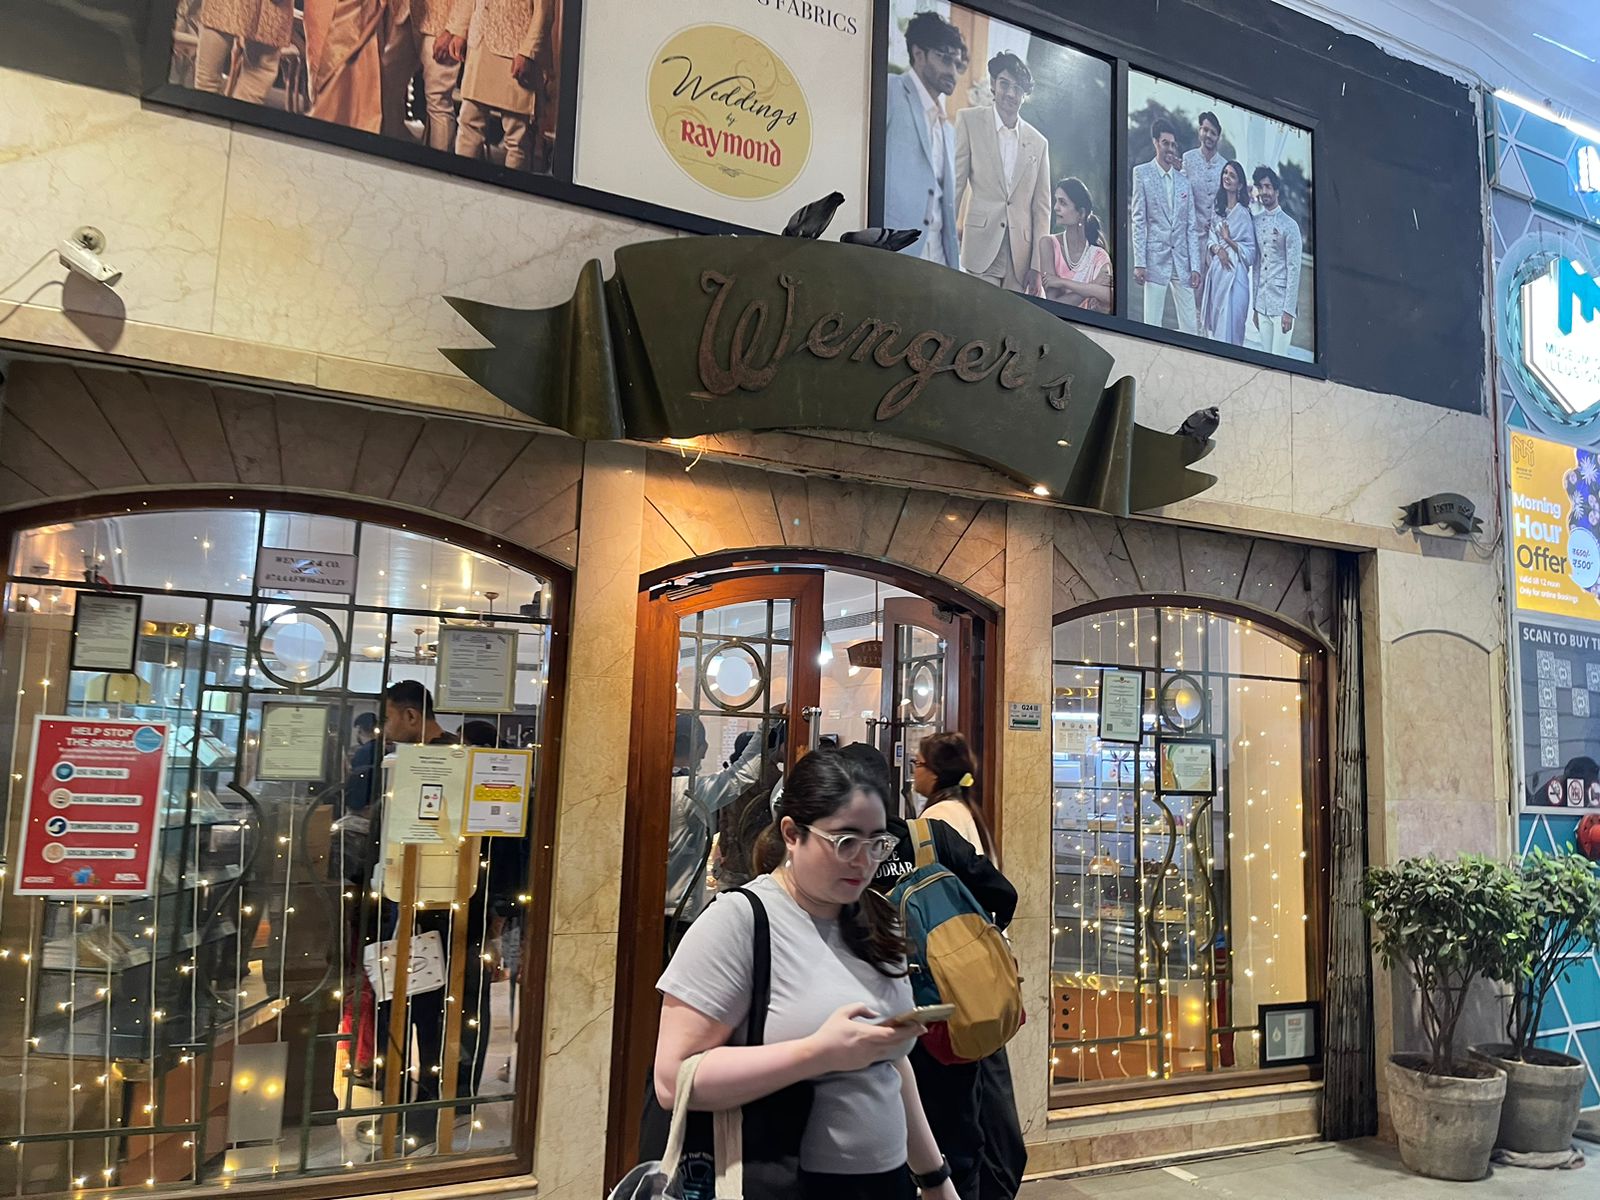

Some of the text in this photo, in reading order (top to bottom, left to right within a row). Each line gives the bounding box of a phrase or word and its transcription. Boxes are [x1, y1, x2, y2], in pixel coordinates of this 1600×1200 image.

[661, 55, 798, 132] Weddings
[680, 118, 782, 167] Raymond
[697, 269, 1076, 422] Wenger's
[1513, 492, 1561, 520] Morning
[1514, 512, 1562, 544] Hour
[1516, 544, 1567, 574] Offer
[1523, 627, 1551, 644] SCAN
[1553, 632, 1567, 645] TO
[1569, 634, 1589, 649] BUY
[1021, 704, 1033, 712] G24
[65, 737, 90, 747] THE
[90, 738, 135, 749] SPREAD
[71, 726, 134, 738] HELP STOP
